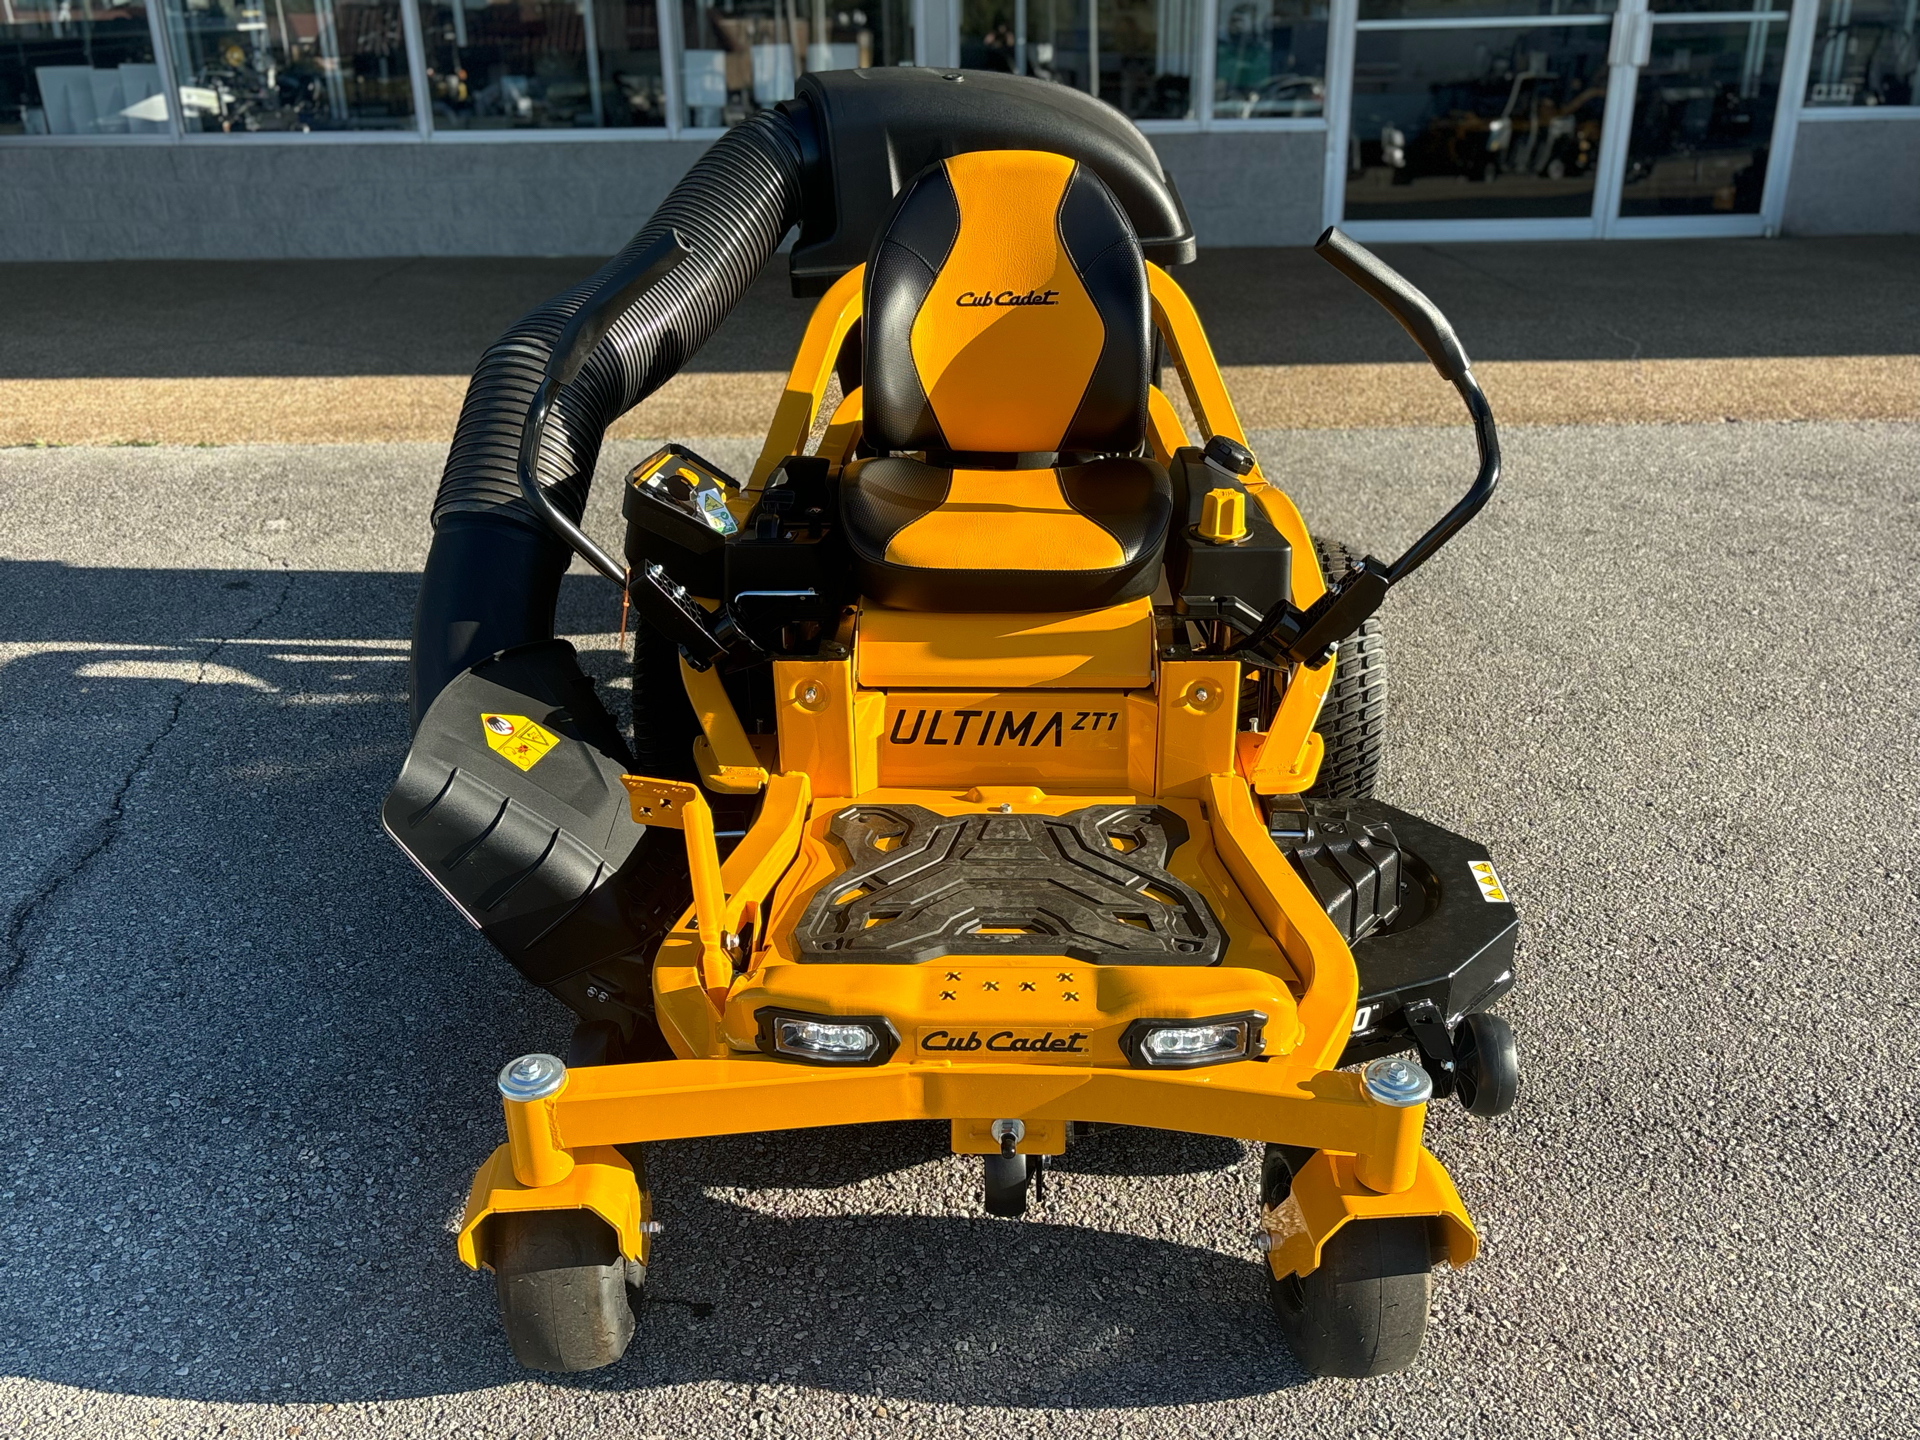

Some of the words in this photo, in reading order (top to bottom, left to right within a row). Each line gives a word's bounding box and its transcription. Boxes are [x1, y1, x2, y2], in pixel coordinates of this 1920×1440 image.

[956, 291, 993, 307] Cub
[889, 709, 1063, 747] ULTIMA
[1070, 711, 1119, 731] ZT1
[921, 1030, 982, 1051] Cub
